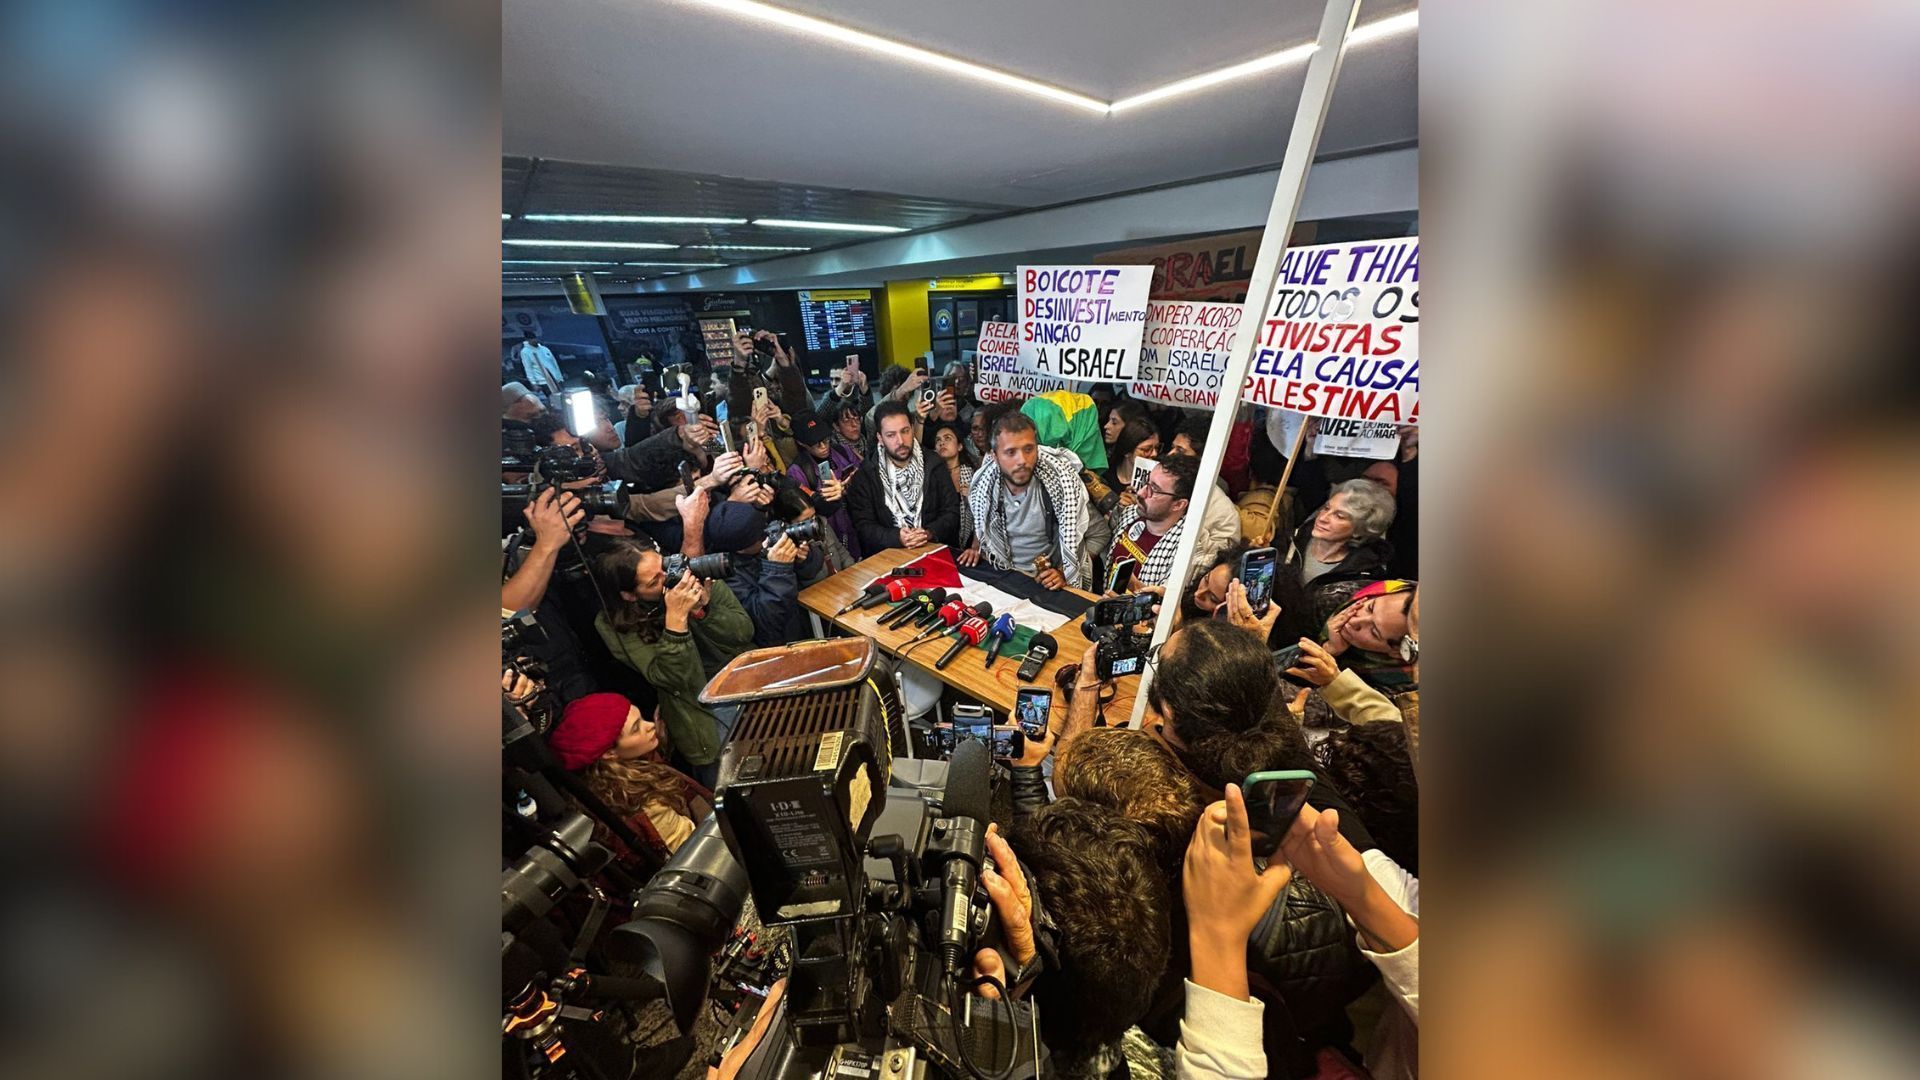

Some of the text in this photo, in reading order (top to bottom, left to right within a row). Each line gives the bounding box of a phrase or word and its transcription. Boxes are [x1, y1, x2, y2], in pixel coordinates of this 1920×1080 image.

[1025, 269, 1120, 294] BOICOTE
[1273, 287, 1361, 322] TODOS
[985, 322, 1019, 339] RELA
[1059, 348, 1133, 380] ISRAEL
[979, 373, 1065, 393] SUA MÁQUINA
[1137, 366, 1223, 389] ESTADO Q
[1132, 382, 1220, 406] MATA CRIAN
[1373, 429, 1397, 439] MAR
